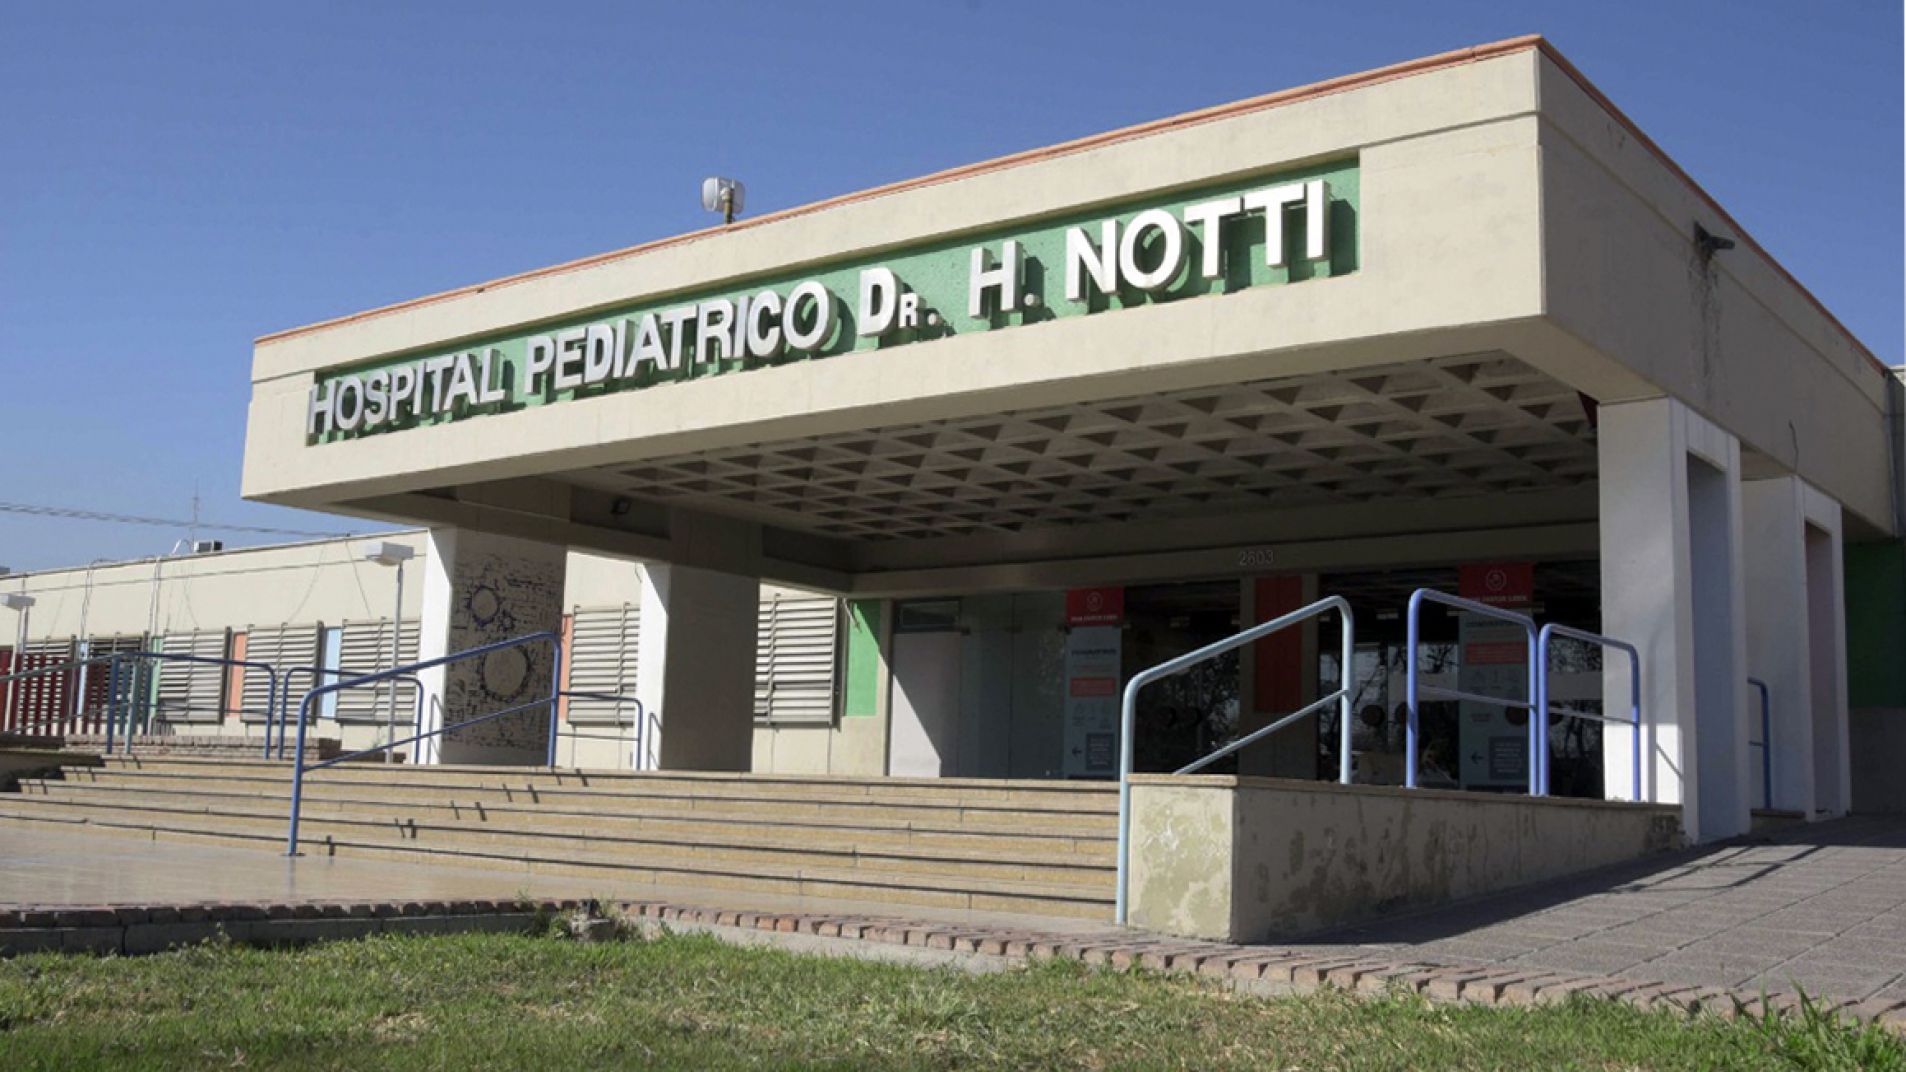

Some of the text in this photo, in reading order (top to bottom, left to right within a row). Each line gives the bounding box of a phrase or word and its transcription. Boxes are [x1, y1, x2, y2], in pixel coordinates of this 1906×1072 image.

[307, 348, 505, 434] HOSPITAL
[524, 281, 833, 393] PEDIATRICO
[969, 241, 1041, 320] H.
[1066, 180, 1331, 302] NOTTI
[1240, 549, 1274, 565] 2603
